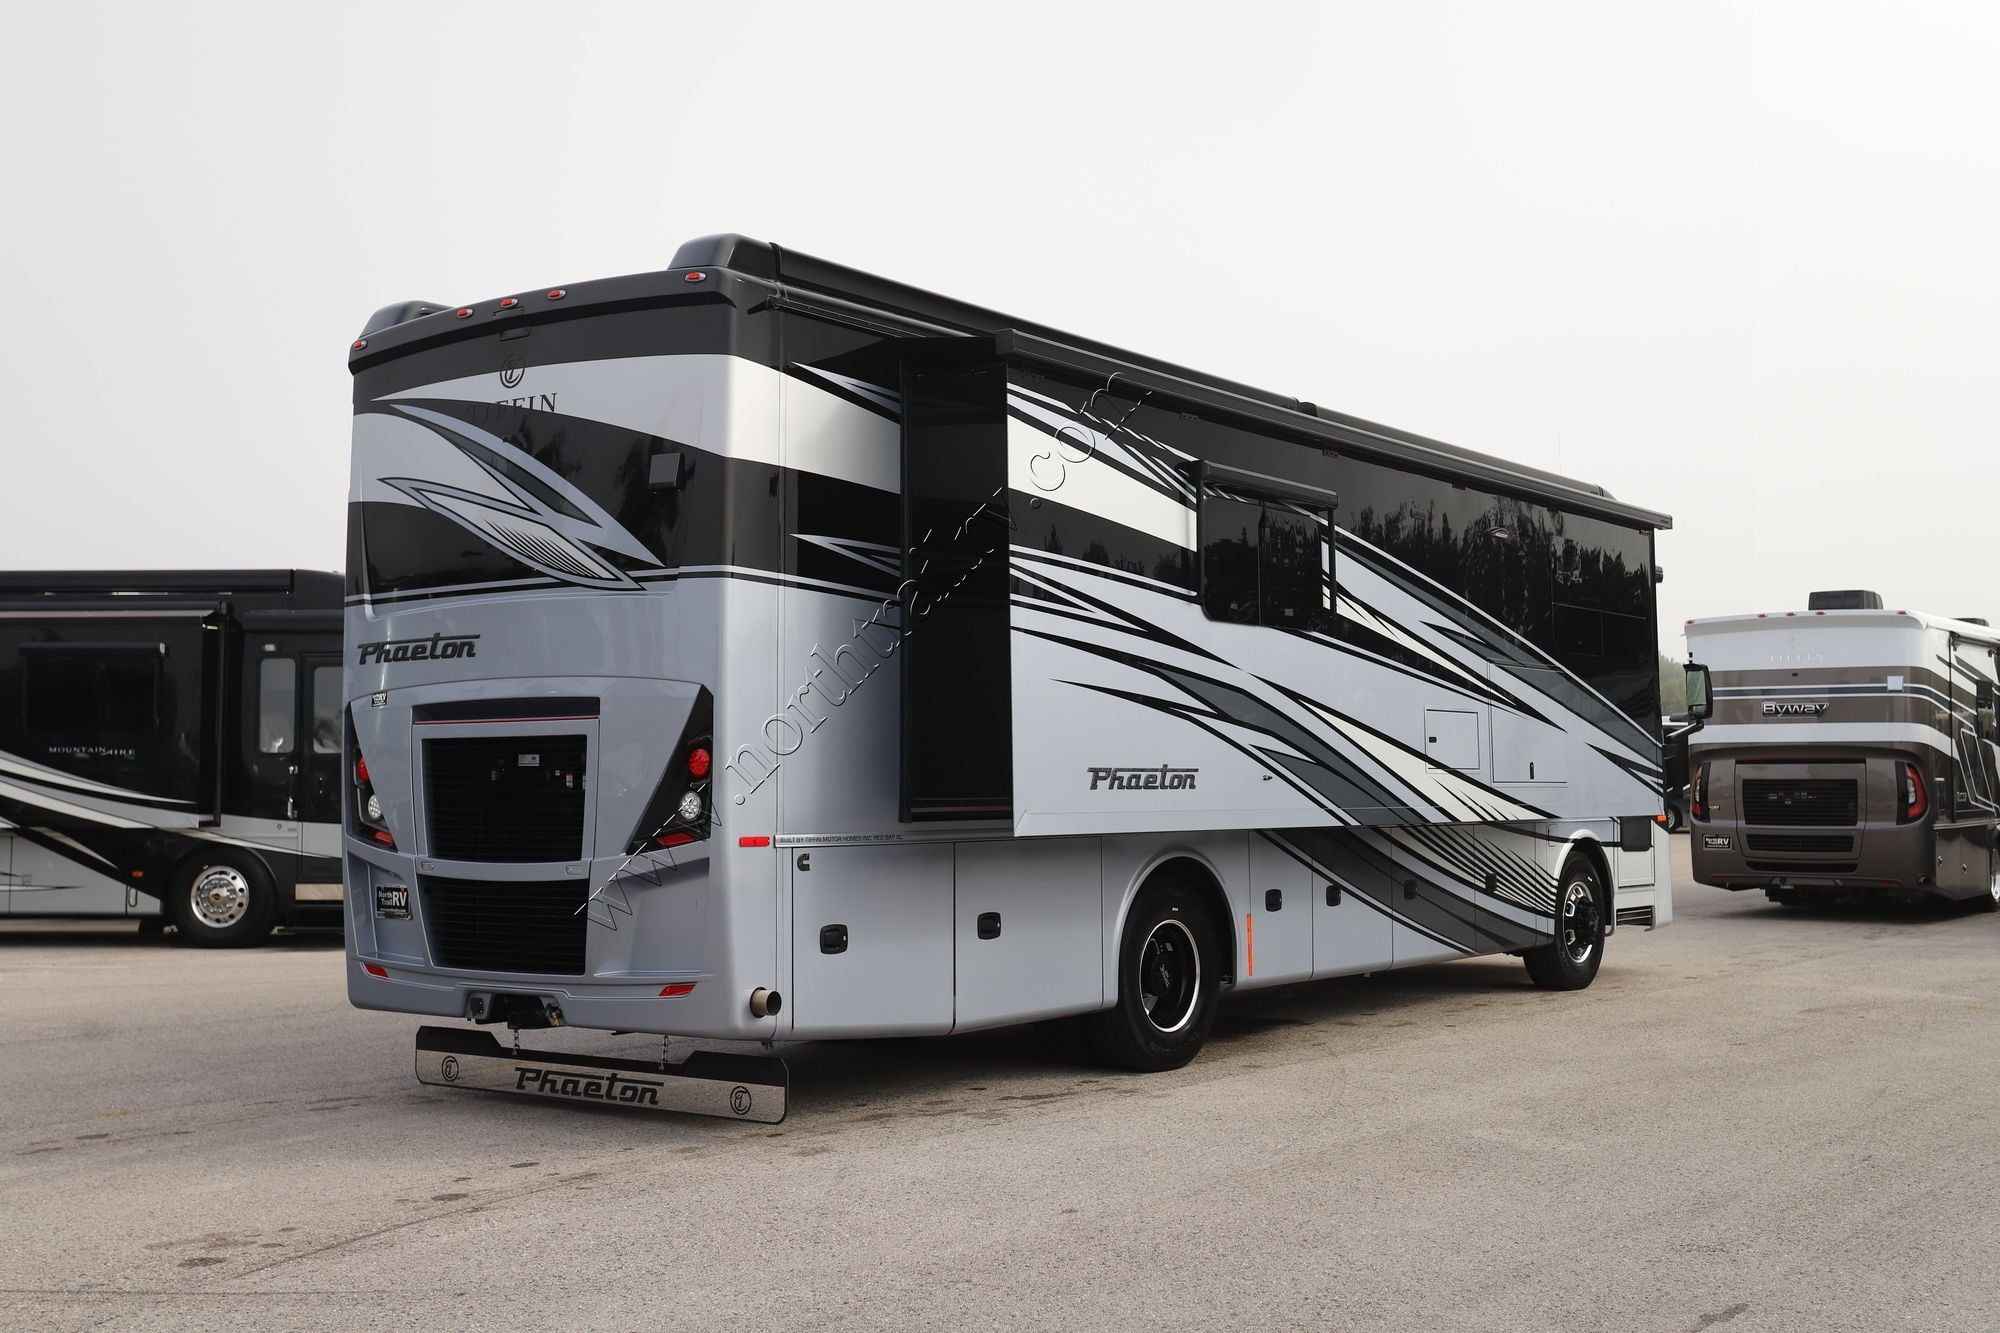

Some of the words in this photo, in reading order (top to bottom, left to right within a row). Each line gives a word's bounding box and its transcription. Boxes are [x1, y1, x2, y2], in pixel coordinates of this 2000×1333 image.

[357, 632, 481, 665] Phaeton
[1763, 703, 1828, 717] Byway
[1087, 764, 1200, 790] Phaeton
[392, 891, 407, 906] RV
[515, 1067, 665, 1105] Phaeton
